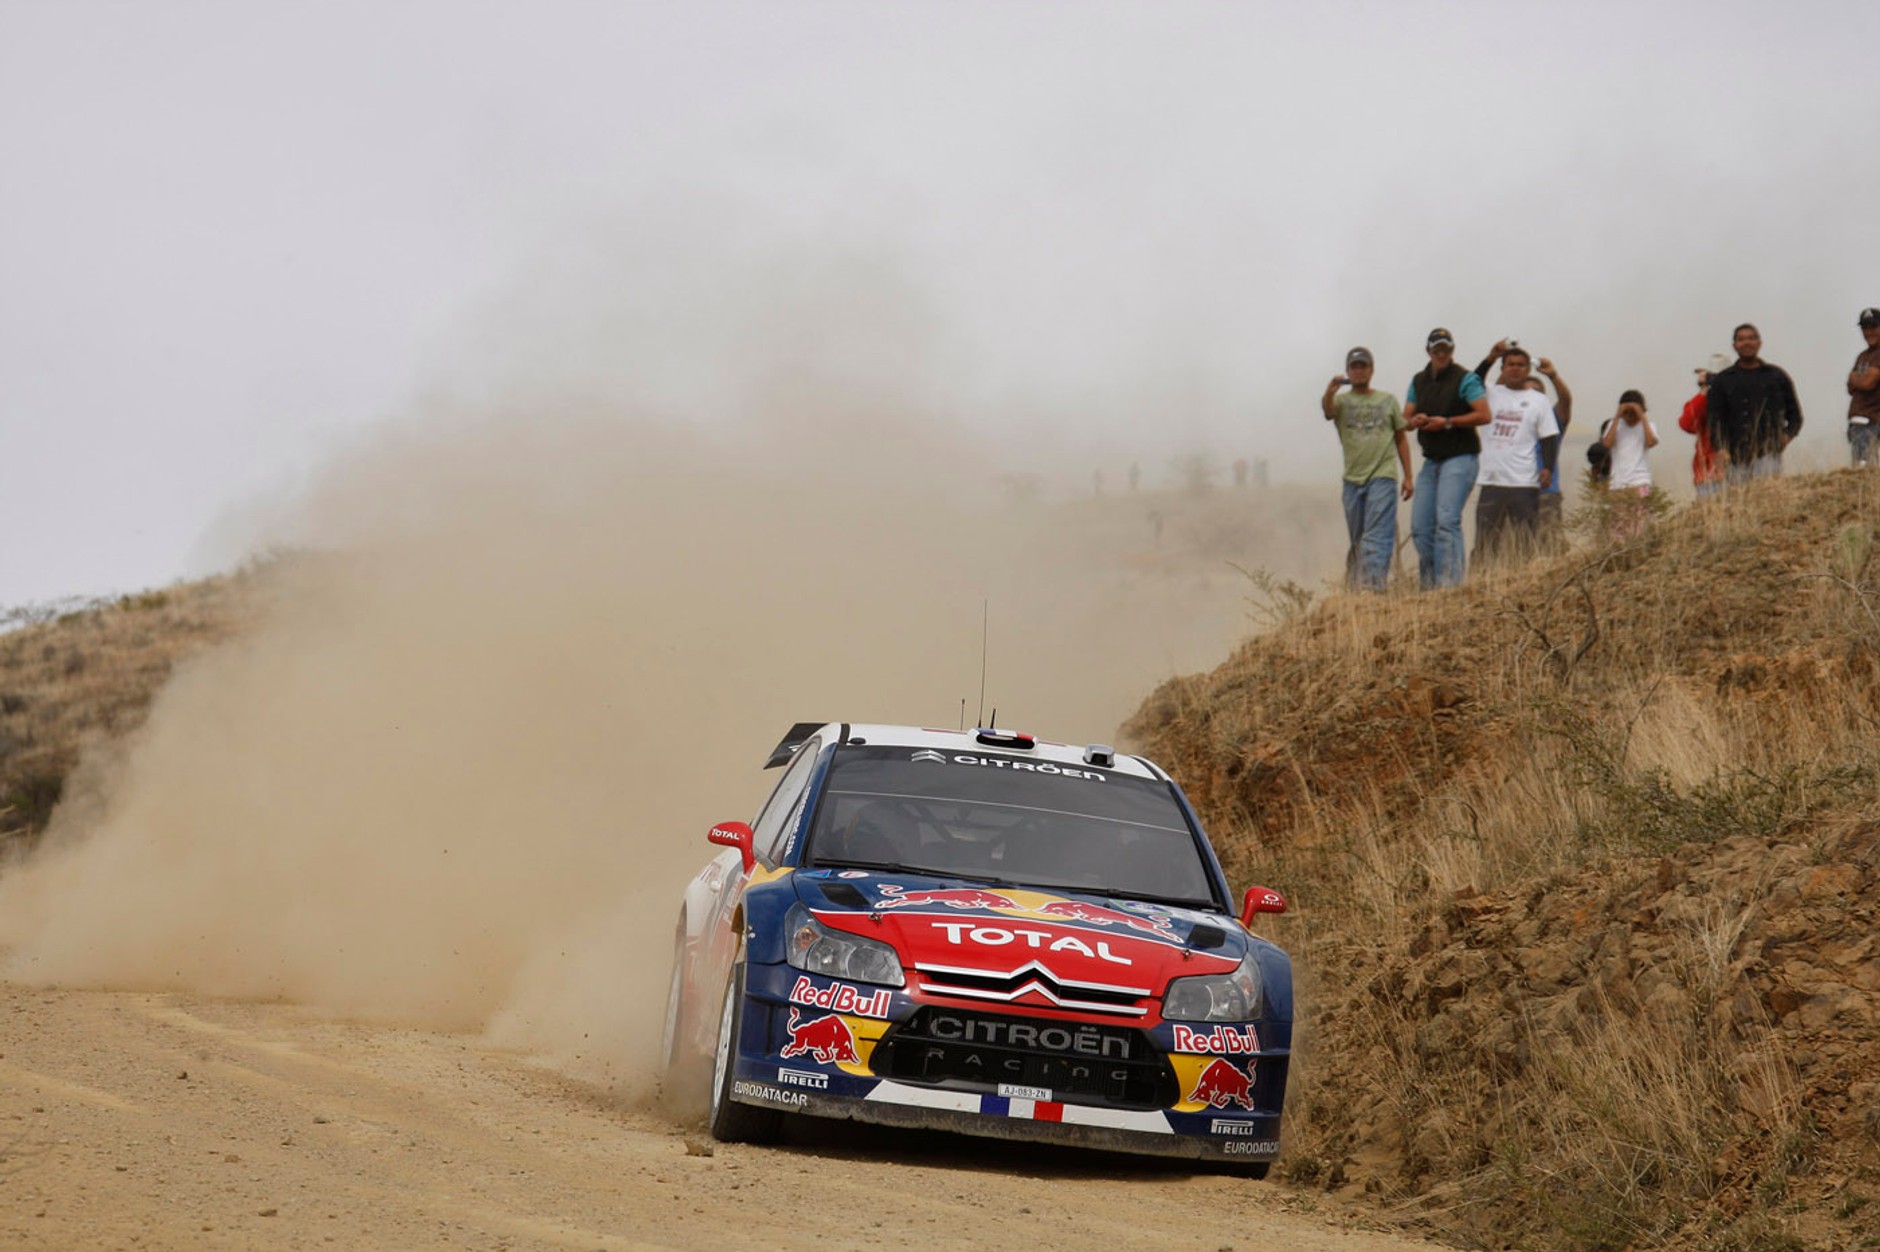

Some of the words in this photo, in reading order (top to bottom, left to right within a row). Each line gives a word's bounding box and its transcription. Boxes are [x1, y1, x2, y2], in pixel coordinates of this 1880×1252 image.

[711, 828, 740, 840] TOTAL
[931, 922, 1132, 965] TOTAL
[789, 975, 841, 1010] Red
[831, 984, 892, 1019] Bull
[1172, 1024, 1228, 1055] Red
[1223, 1023, 1261, 1055] Bull
[777, 1066, 829, 1089] PIRELLI
[734, 1081, 808, 1107] EURODATACAR
[1210, 1118, 1254, 1136] PIRELLI
